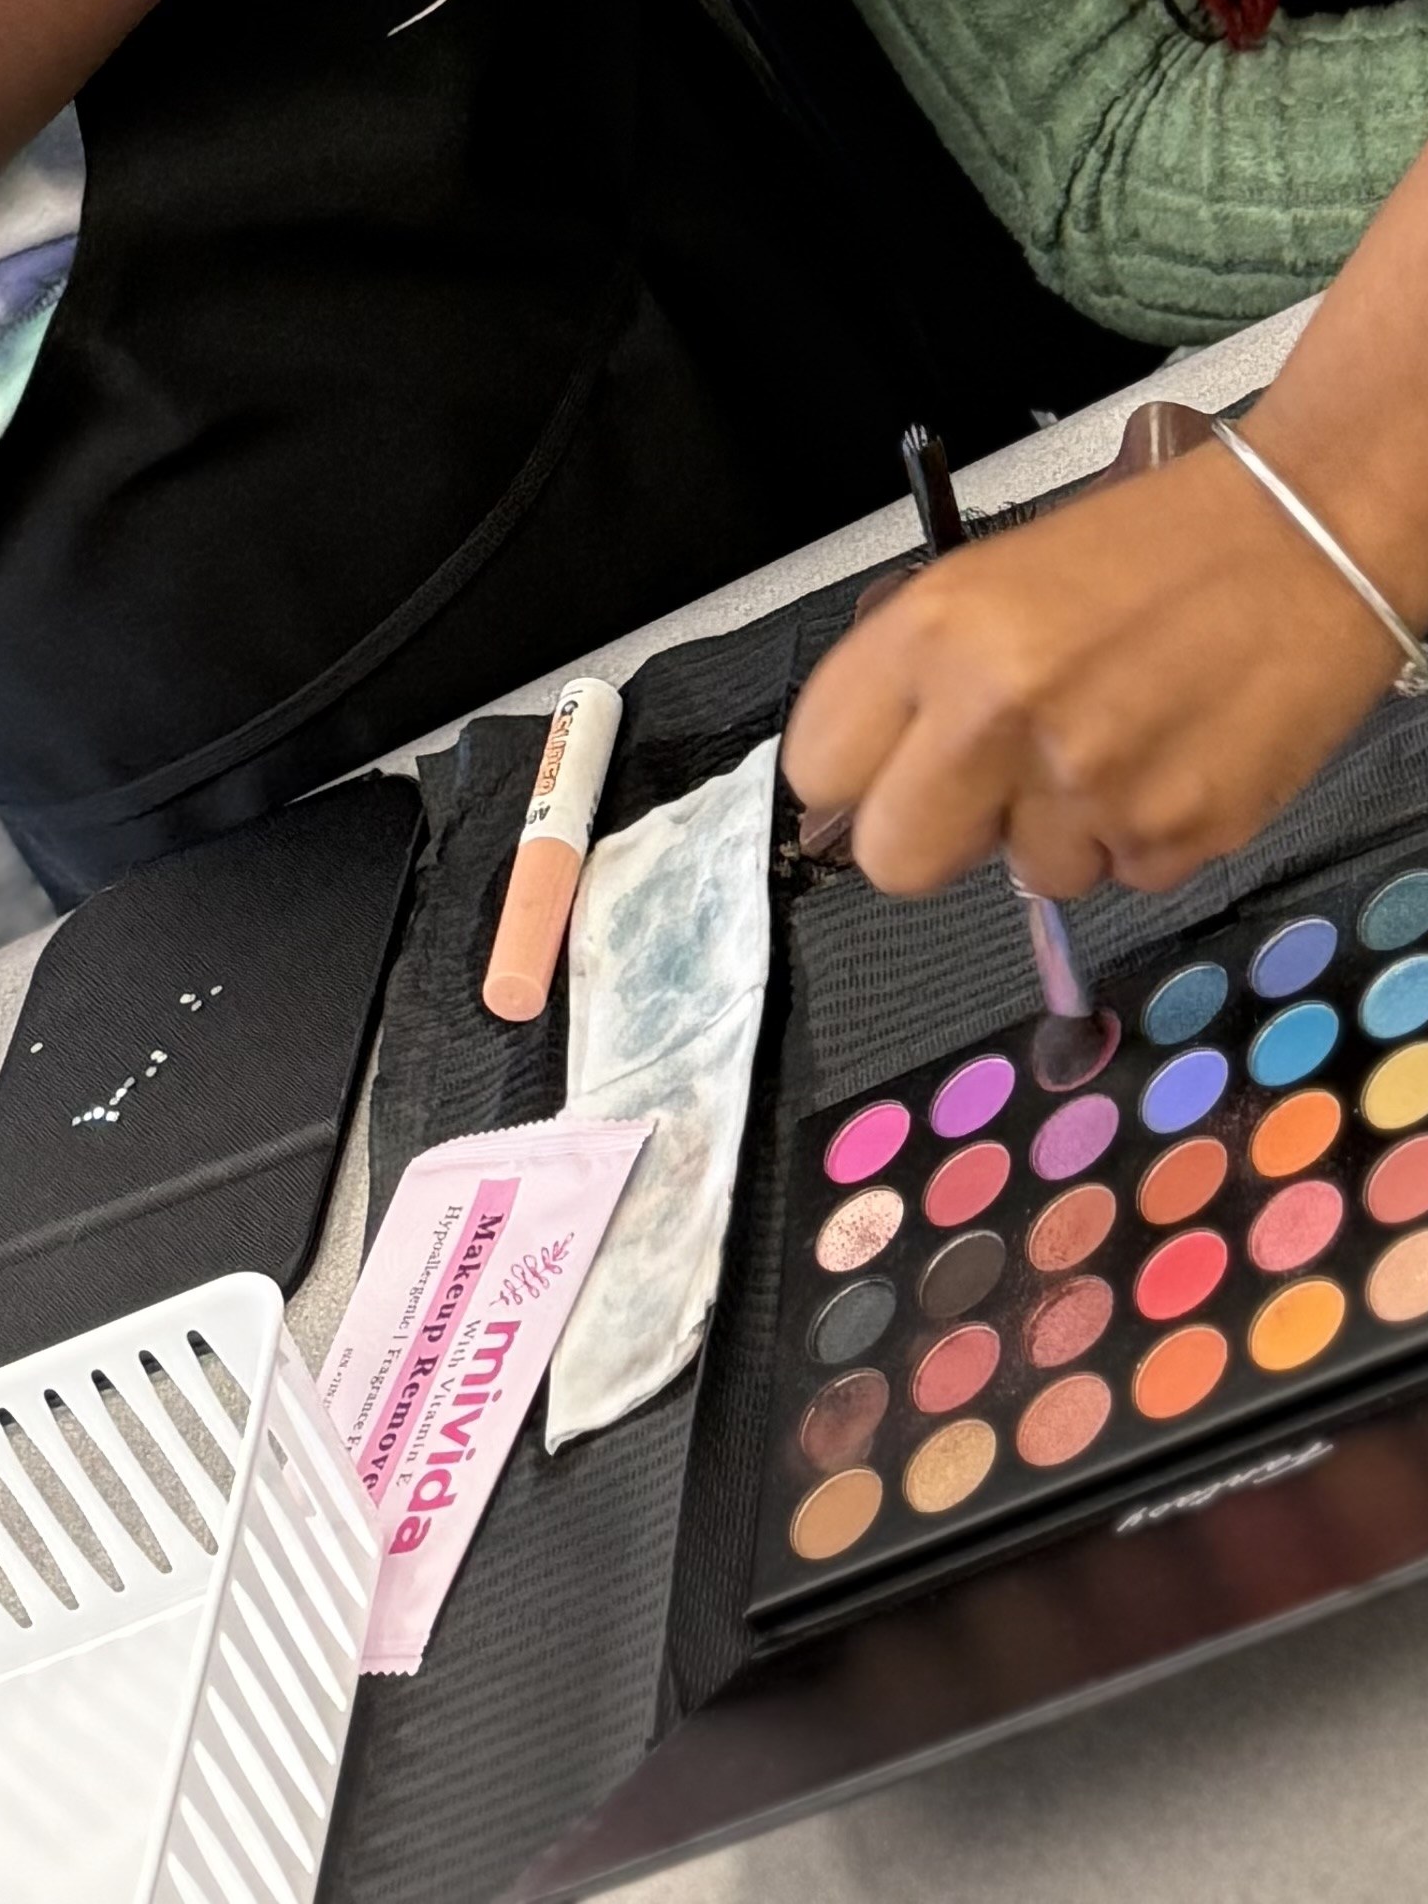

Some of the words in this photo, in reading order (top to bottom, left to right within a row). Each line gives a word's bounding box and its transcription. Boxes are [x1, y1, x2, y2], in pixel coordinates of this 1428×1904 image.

[396, 1204, 463, 1333] Hypoallergenic
[422, 1213, 505, 1346] Makeup
[352, 1348, 402, 1432] Fragrance
[445, 1319, 482, 1371] With
[388, 1320, 522, 1556] mivida
[408, 1375, 457, 1469] Vitamin
[395, 1471, 413, 1488] E
